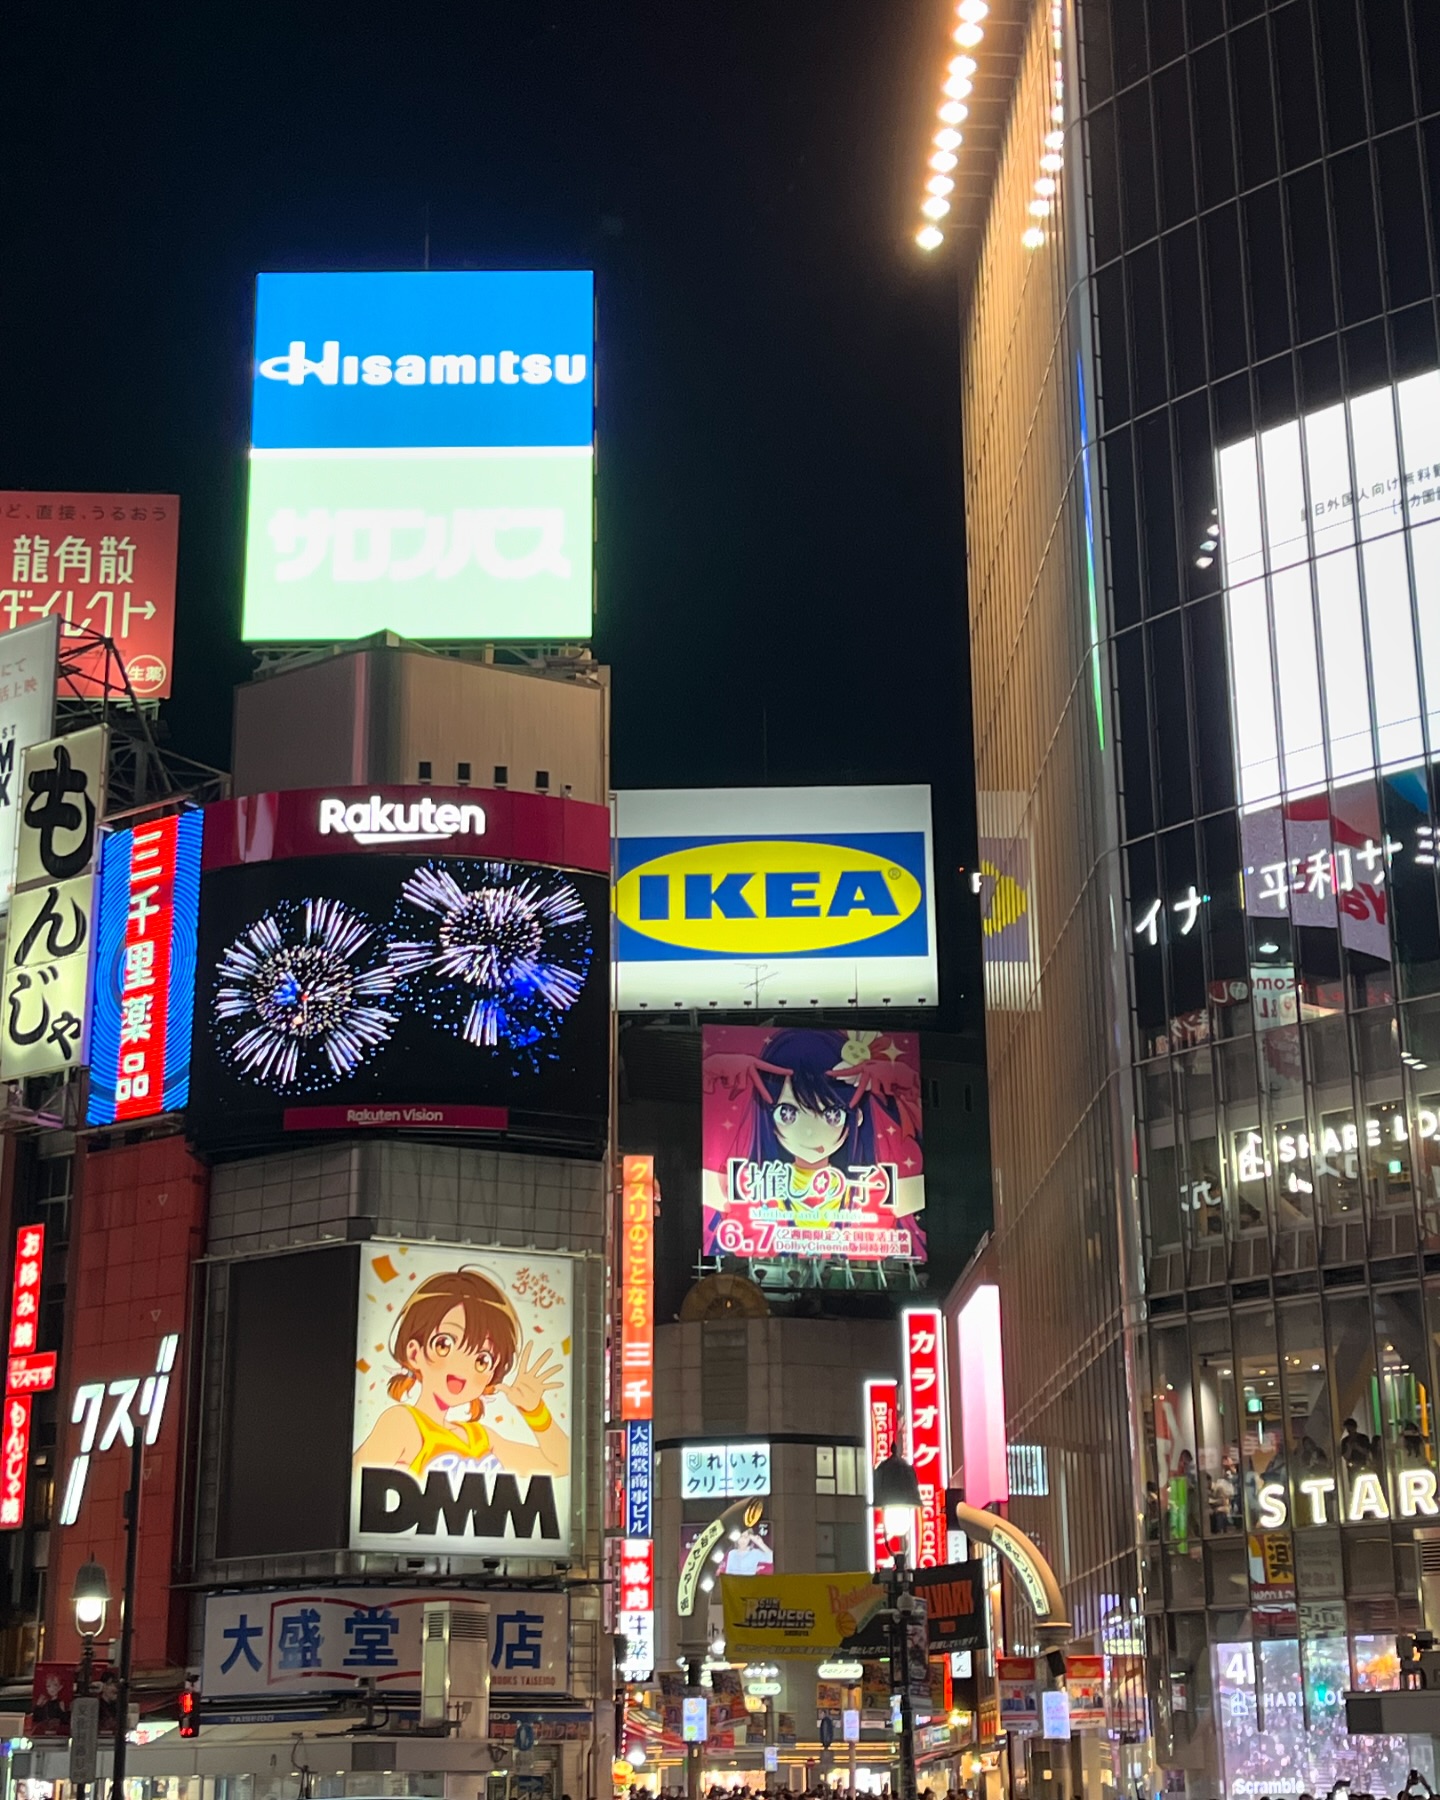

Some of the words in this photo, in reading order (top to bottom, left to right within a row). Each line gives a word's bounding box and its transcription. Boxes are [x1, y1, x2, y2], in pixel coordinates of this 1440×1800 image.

[259, 341, 587, 386] Hisamitsu
[0, 504, 167, 520] ど、直接、うるおう
[12, 534, 137, 584] 龍角散
[268, 506, 572, 582] サロンパス
[128, 666, 162, 682] 生薬
[319, 796, 487, 838] Rakuten
[10, 745, 95, 1060] もんじゃ
[639, 870, 900, 920] IKEA
[115, 830, 162, 1100] 三千里薬品
[347, 1109, 400, 1122] Rakuten
[403, 1108, 443, 1122] Vision
[1279, 1120, 1381, 1163] SHARE
[718, 1221, 776, 1251] 6.7
[873, 1402, 888, 1431] BIG
[911, 1329, 940, 1467] カラオケ
[707, 1451, 767, 1469] れいわ
[878, 1432, 889, 1464] ECH
[360, 1466, 561, 1540] DMM
[687, 1475, 767, 1493] クリニック
[918, 1484, 934, 1518] BIG
[1258, 1469, 1439, 1528] STAR
[920, 1521, 937, 1568] ECHO
[221, 1608, 545, 1674] 大盛堂店
[1233, 1777, 1305, 1795] Scramble
